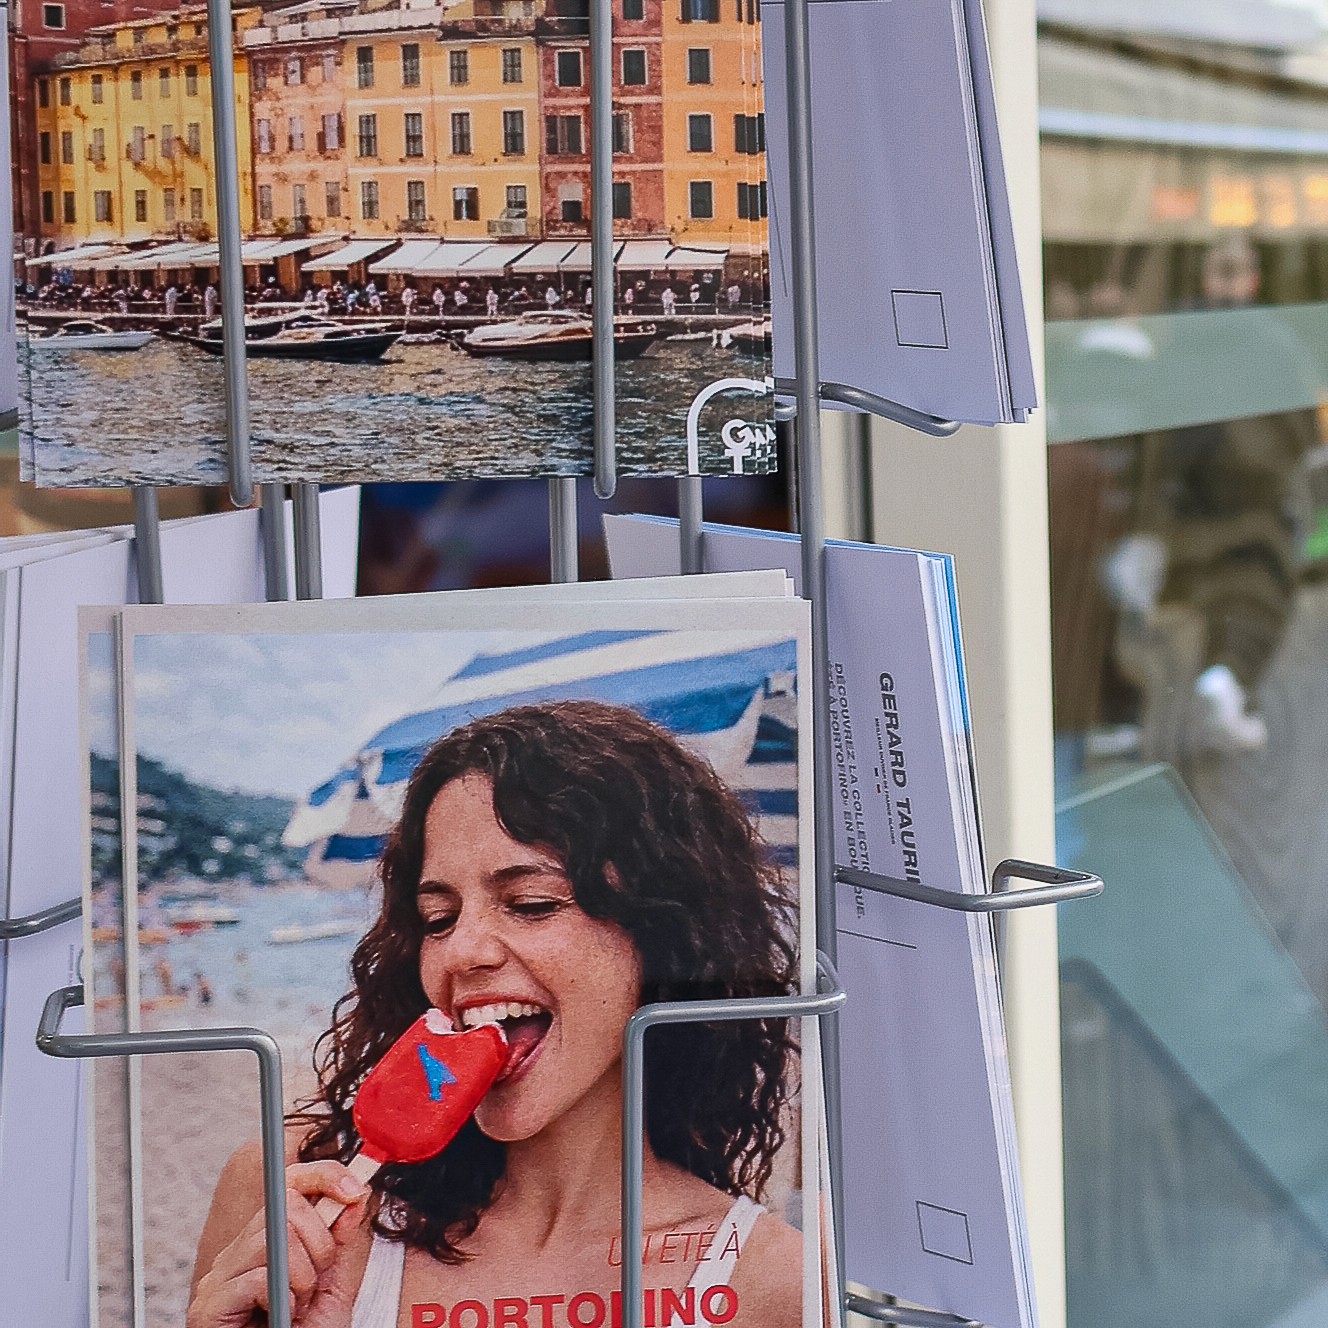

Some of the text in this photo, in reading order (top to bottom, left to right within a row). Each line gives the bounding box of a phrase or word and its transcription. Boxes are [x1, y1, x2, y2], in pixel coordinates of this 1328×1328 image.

[879, 672, 907, 788] GERARD
[659, 1223, 718, 1265] ÉTÉ
[720, 1222, 742, 1262] À
